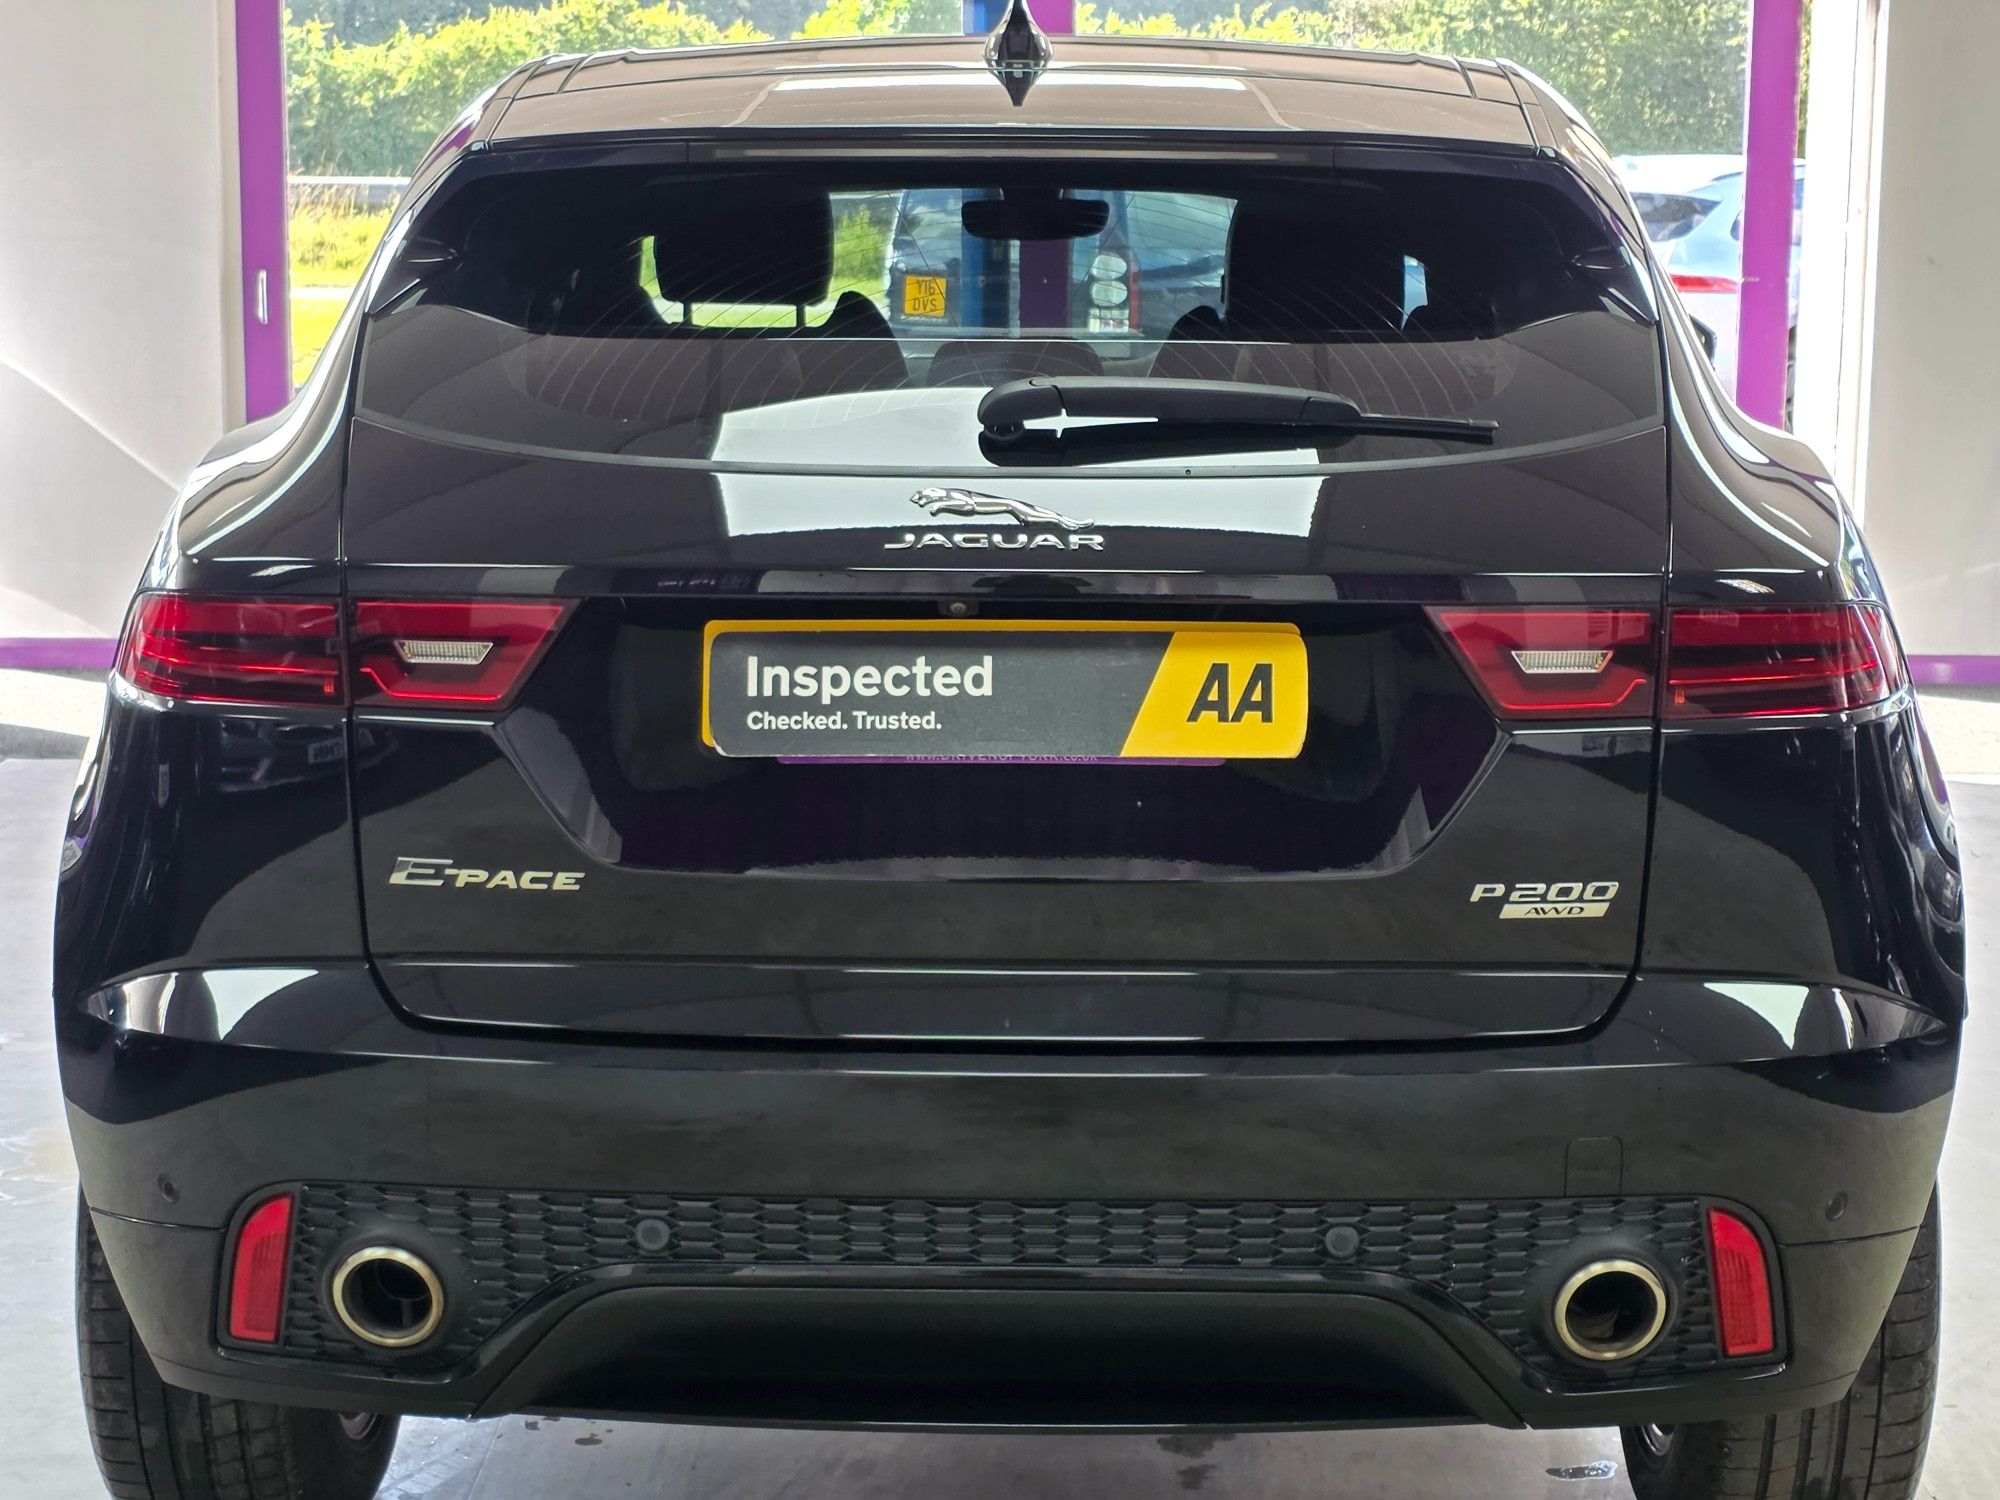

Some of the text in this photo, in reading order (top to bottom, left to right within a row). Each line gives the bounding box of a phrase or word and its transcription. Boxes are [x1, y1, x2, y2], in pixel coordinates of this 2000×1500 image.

[884, 533, 1105, 551] JAGUAR
[747, 655, 993, 705] Inspected
[1185, 662, 1273, 723] AA
[746, 711, 942, 730] Checked. Trusted.
[1469, 881, 1620, 902] P200
[1524, 906, 1585, 916] AWD
